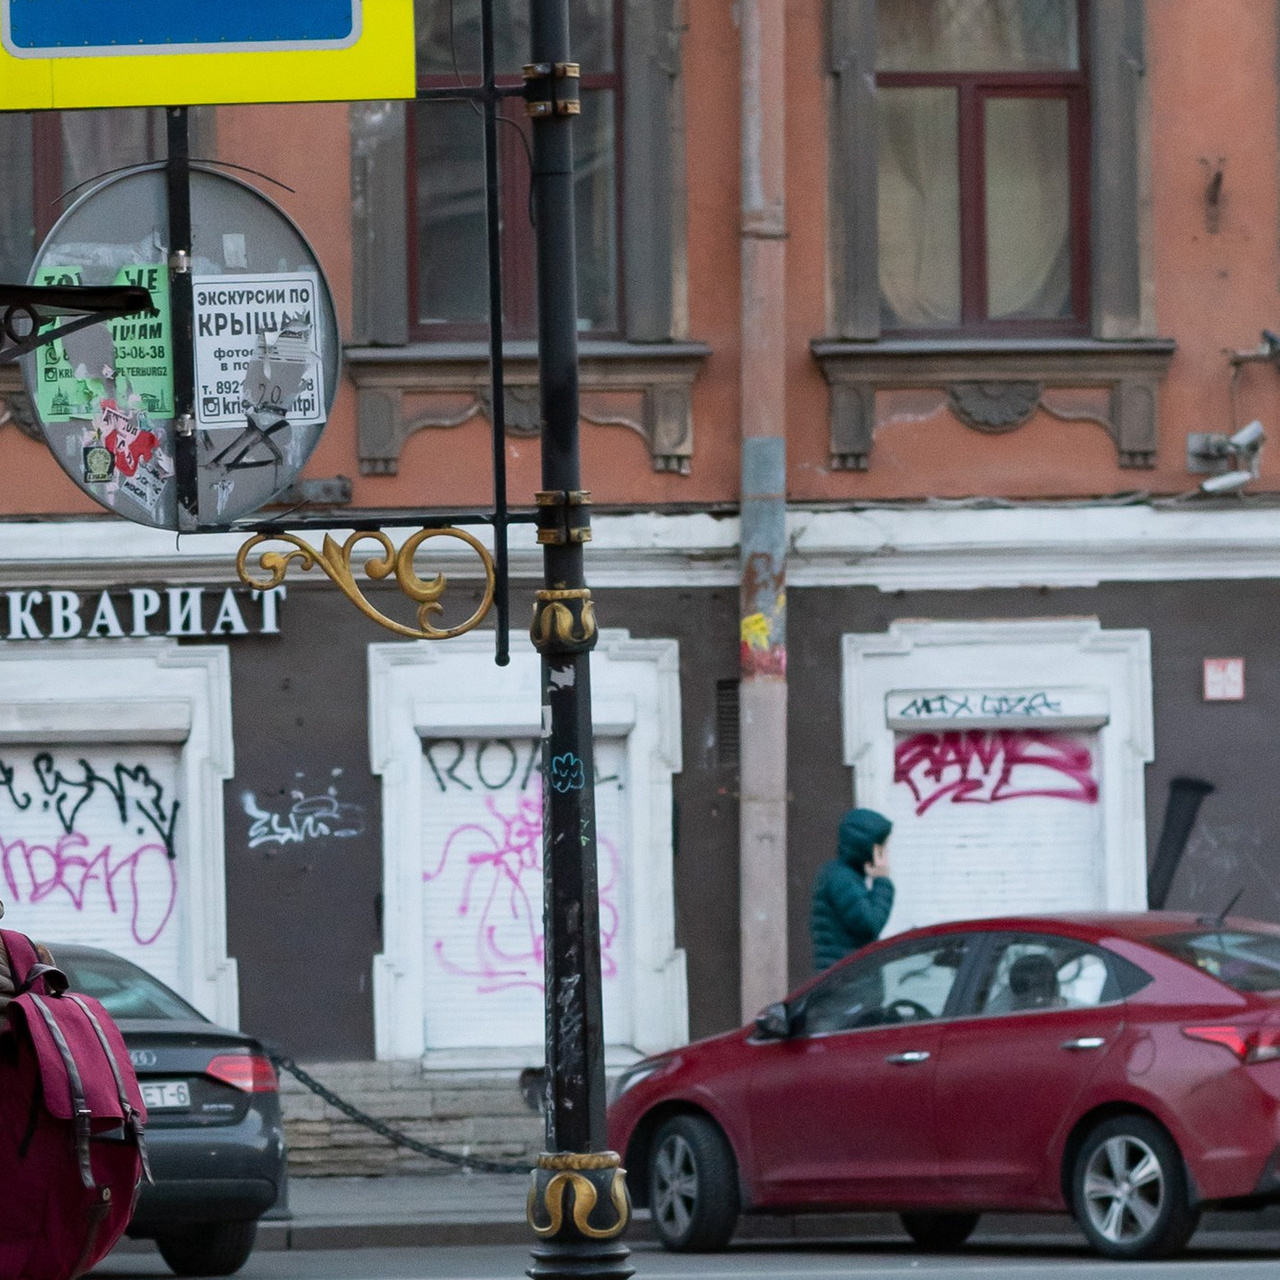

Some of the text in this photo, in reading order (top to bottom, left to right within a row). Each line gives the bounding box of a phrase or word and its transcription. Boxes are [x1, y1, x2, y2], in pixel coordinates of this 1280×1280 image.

[197, 288, 310, 307] ЭКСКУРСИИ ПО
[220, 362, 229, 372] в
